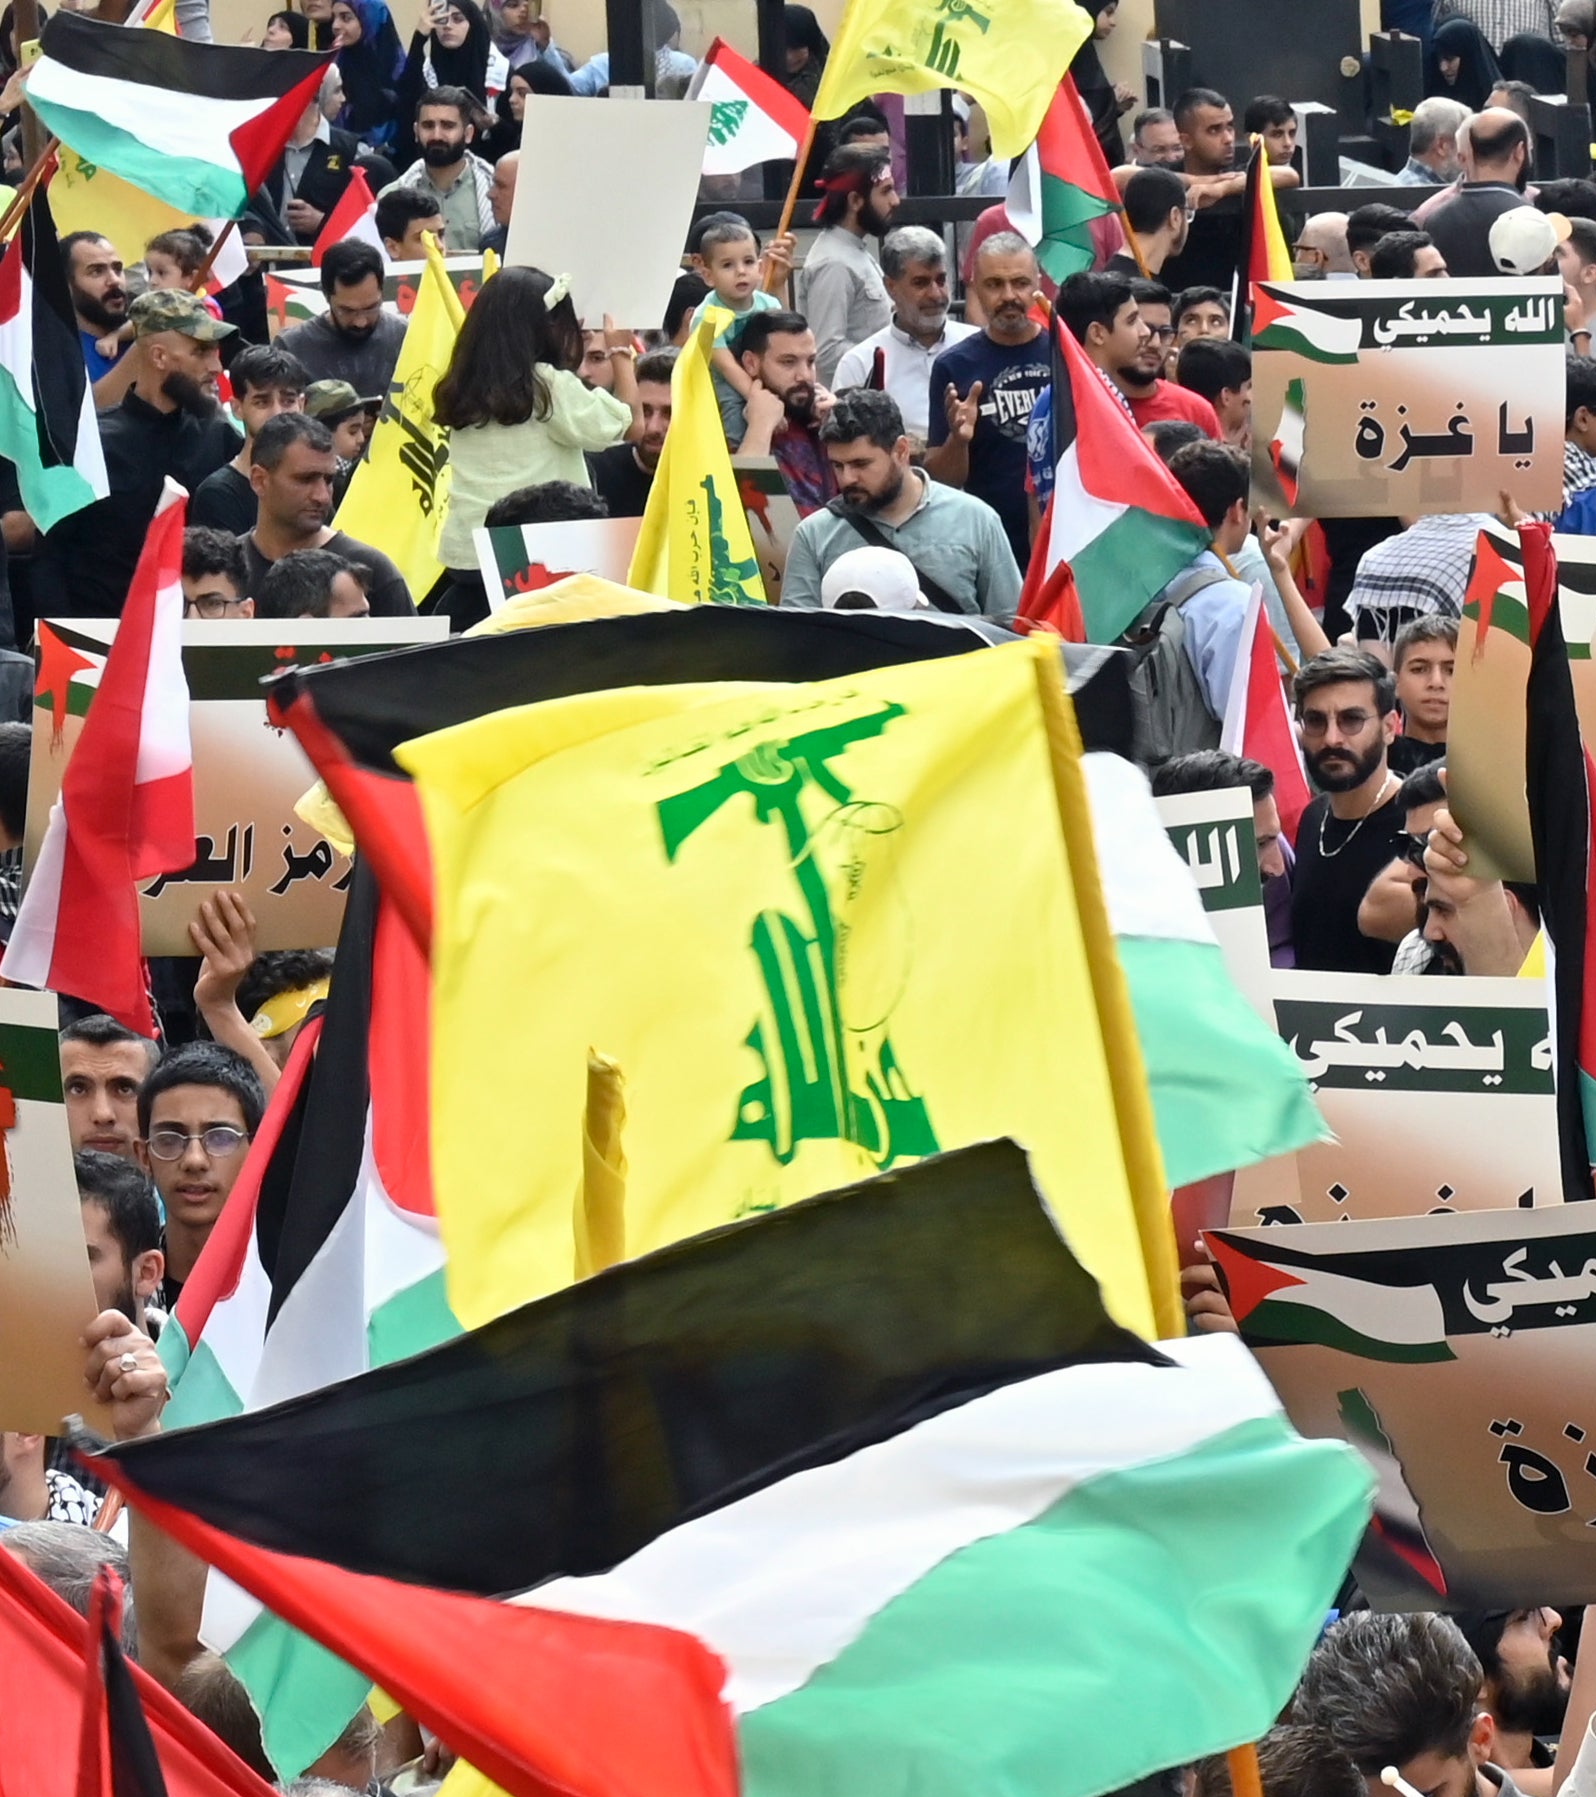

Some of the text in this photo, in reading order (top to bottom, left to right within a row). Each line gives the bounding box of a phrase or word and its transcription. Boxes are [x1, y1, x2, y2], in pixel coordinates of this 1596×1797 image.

[1373, 296, 1555, 352] الله يحميكي
[1355, 400, 1535, 472] يا غزة
